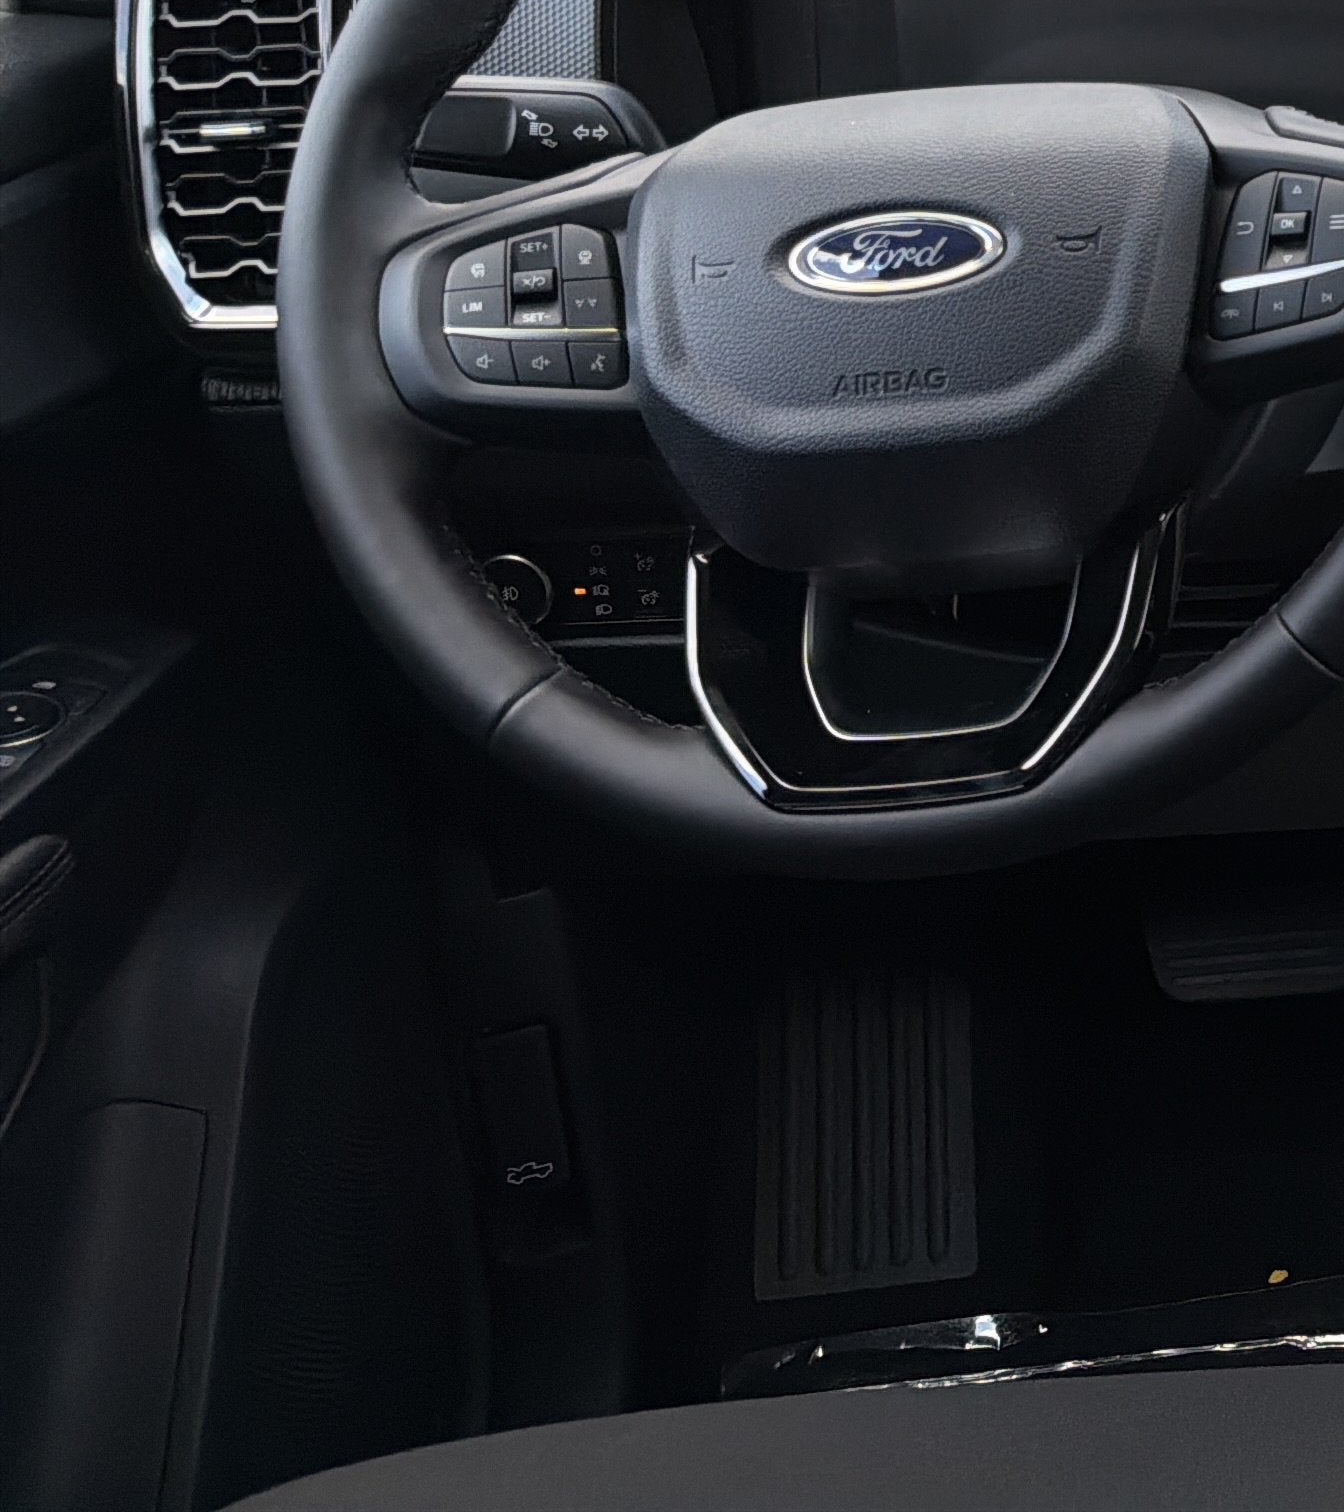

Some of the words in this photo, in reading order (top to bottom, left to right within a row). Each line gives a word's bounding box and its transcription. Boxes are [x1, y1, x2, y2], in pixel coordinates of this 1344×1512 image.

[1280, 218, 1296, 229] OK
[852, 228, 949, 272] Ford
[461, 301, 483, 313] LIM
[831, 368, 949, 398] AIRBAG
